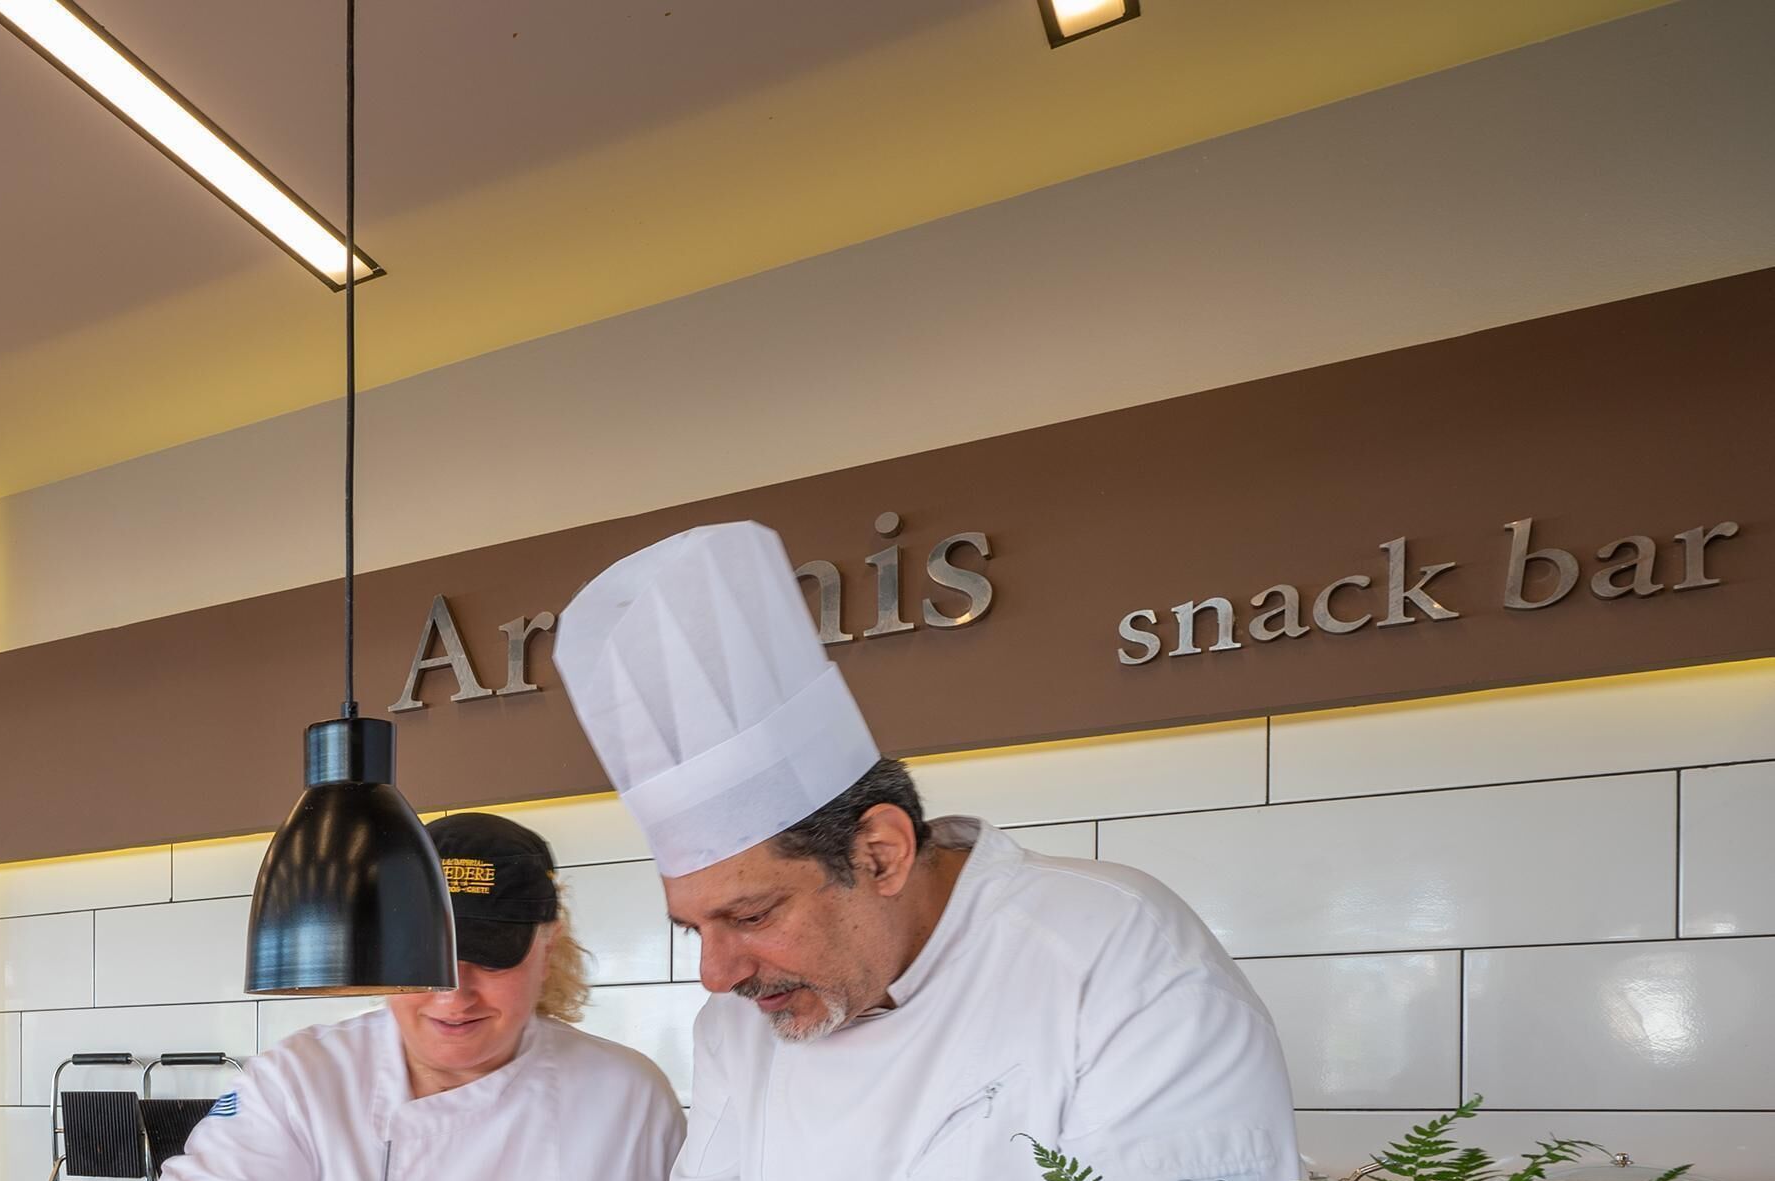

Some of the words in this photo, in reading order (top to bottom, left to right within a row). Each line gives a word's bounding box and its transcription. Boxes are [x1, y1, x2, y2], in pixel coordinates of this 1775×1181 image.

[387, 511, 994, 712] Aris
[1117, 535, 1461, 667] snack
[1503, 517, 1740, 612] bar
[443, 866, 496, 881] EDERE
